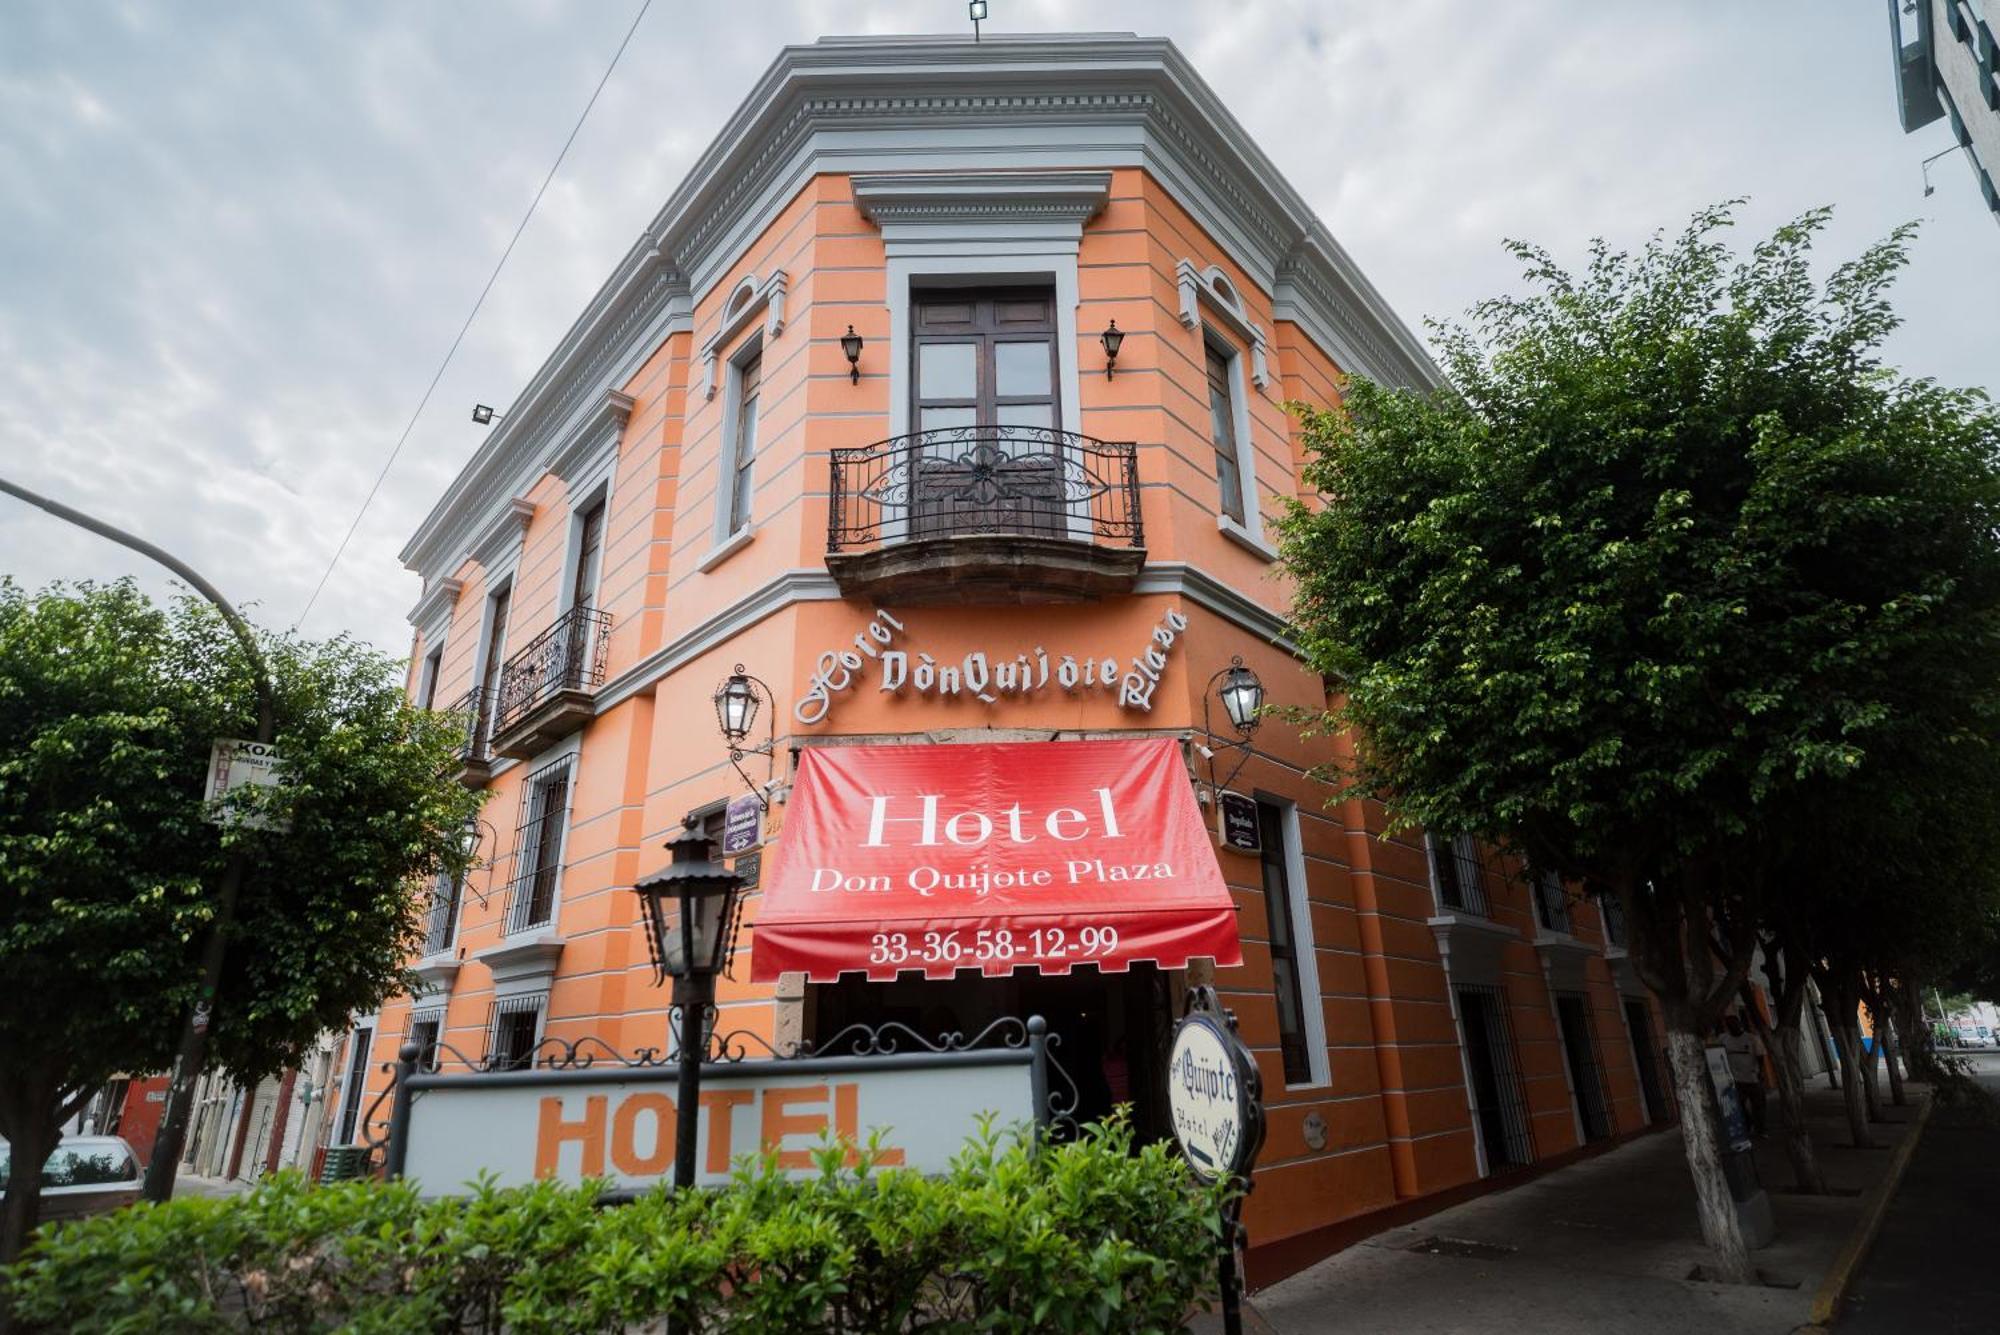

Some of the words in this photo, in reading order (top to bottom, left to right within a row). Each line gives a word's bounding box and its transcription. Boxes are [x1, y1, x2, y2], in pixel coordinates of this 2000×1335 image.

[794, 609, 904, 724] Hotel
[1119, 608, 1188, 712] Plaza
[858, 789, 1127, 847] Hotel
[811, 867, 892, 893] Don
[908, 864, 1051, 896] Quijote
[1067, 859, 1175, 884] Plaza
[870, 926, 1119, 964] 33-36-58-12-99
[1182, 1047, 1235, 1106] Quijote
[534, 1083, 906, 1179] HOTEL
